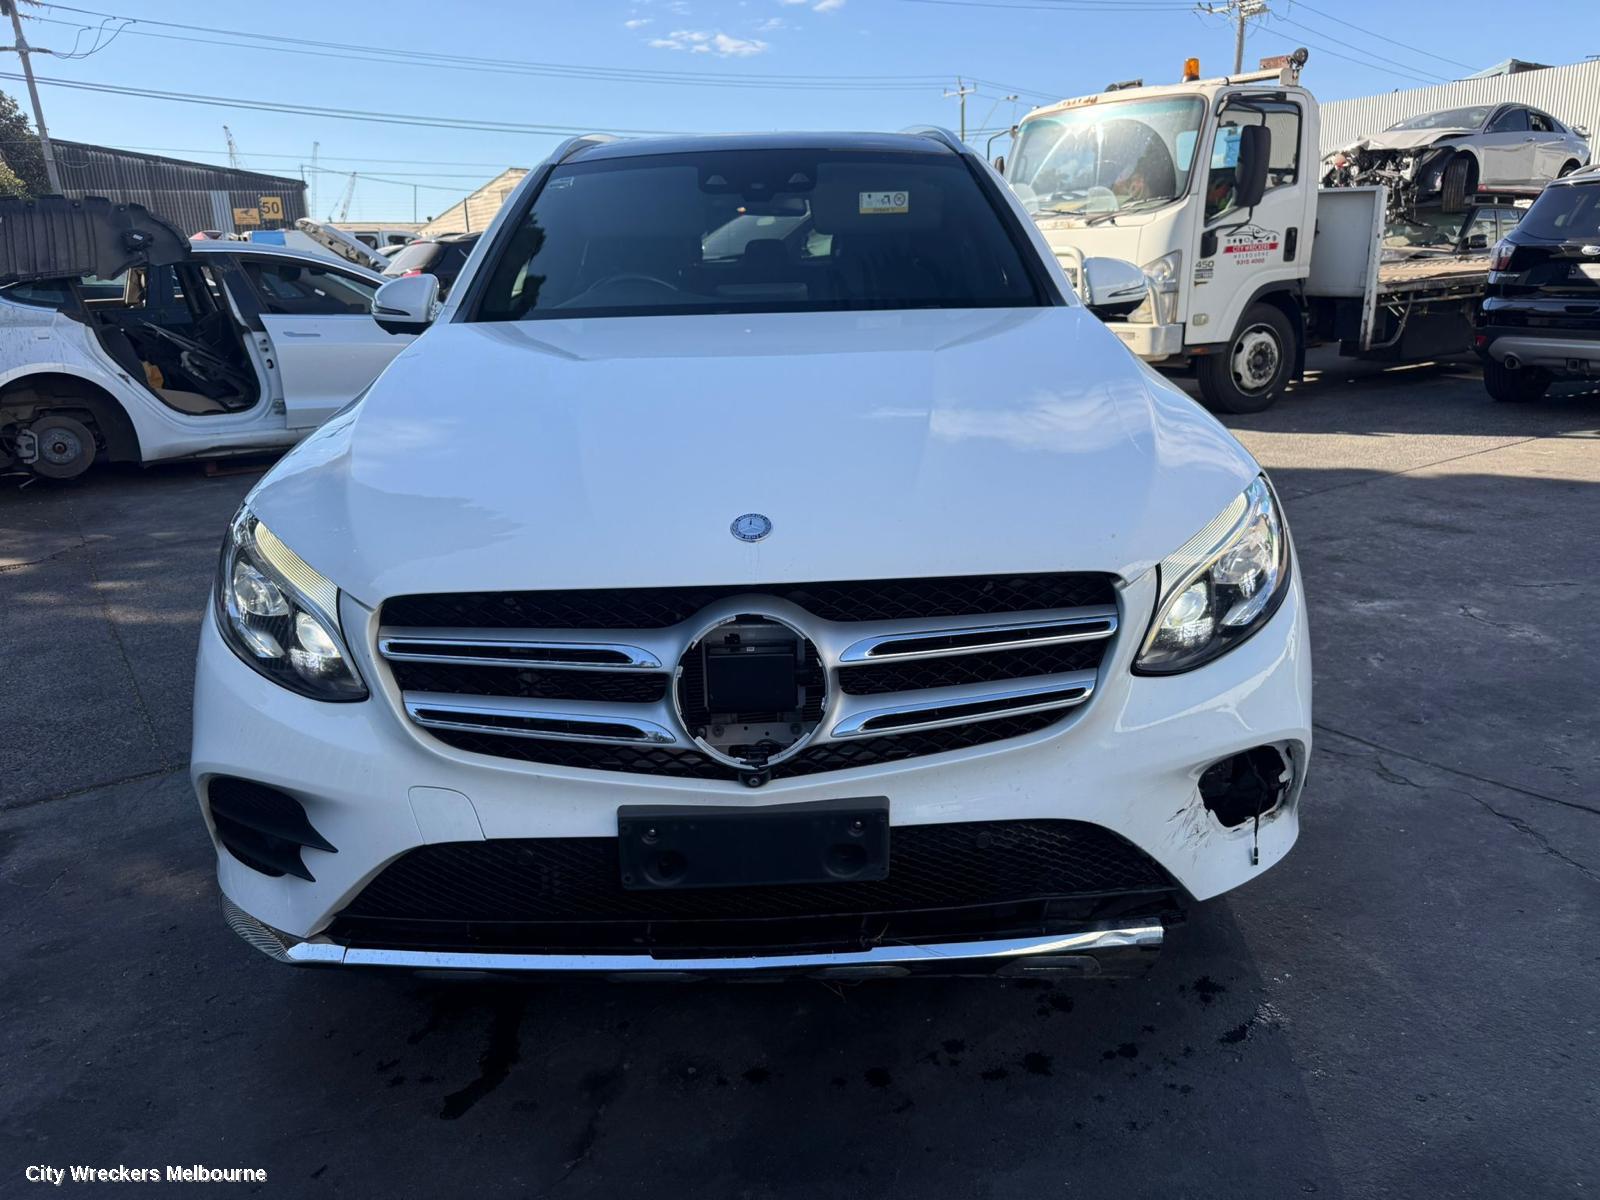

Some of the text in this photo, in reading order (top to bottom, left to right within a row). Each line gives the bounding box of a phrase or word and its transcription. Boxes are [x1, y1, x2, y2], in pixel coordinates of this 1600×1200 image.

[262, 201, 280, 214] 50
[1232, 245, 1244, 253] CITY
[1233, 251, 1269, 259] MELBOURNE
[1195, 260, 1215, 268] 450
